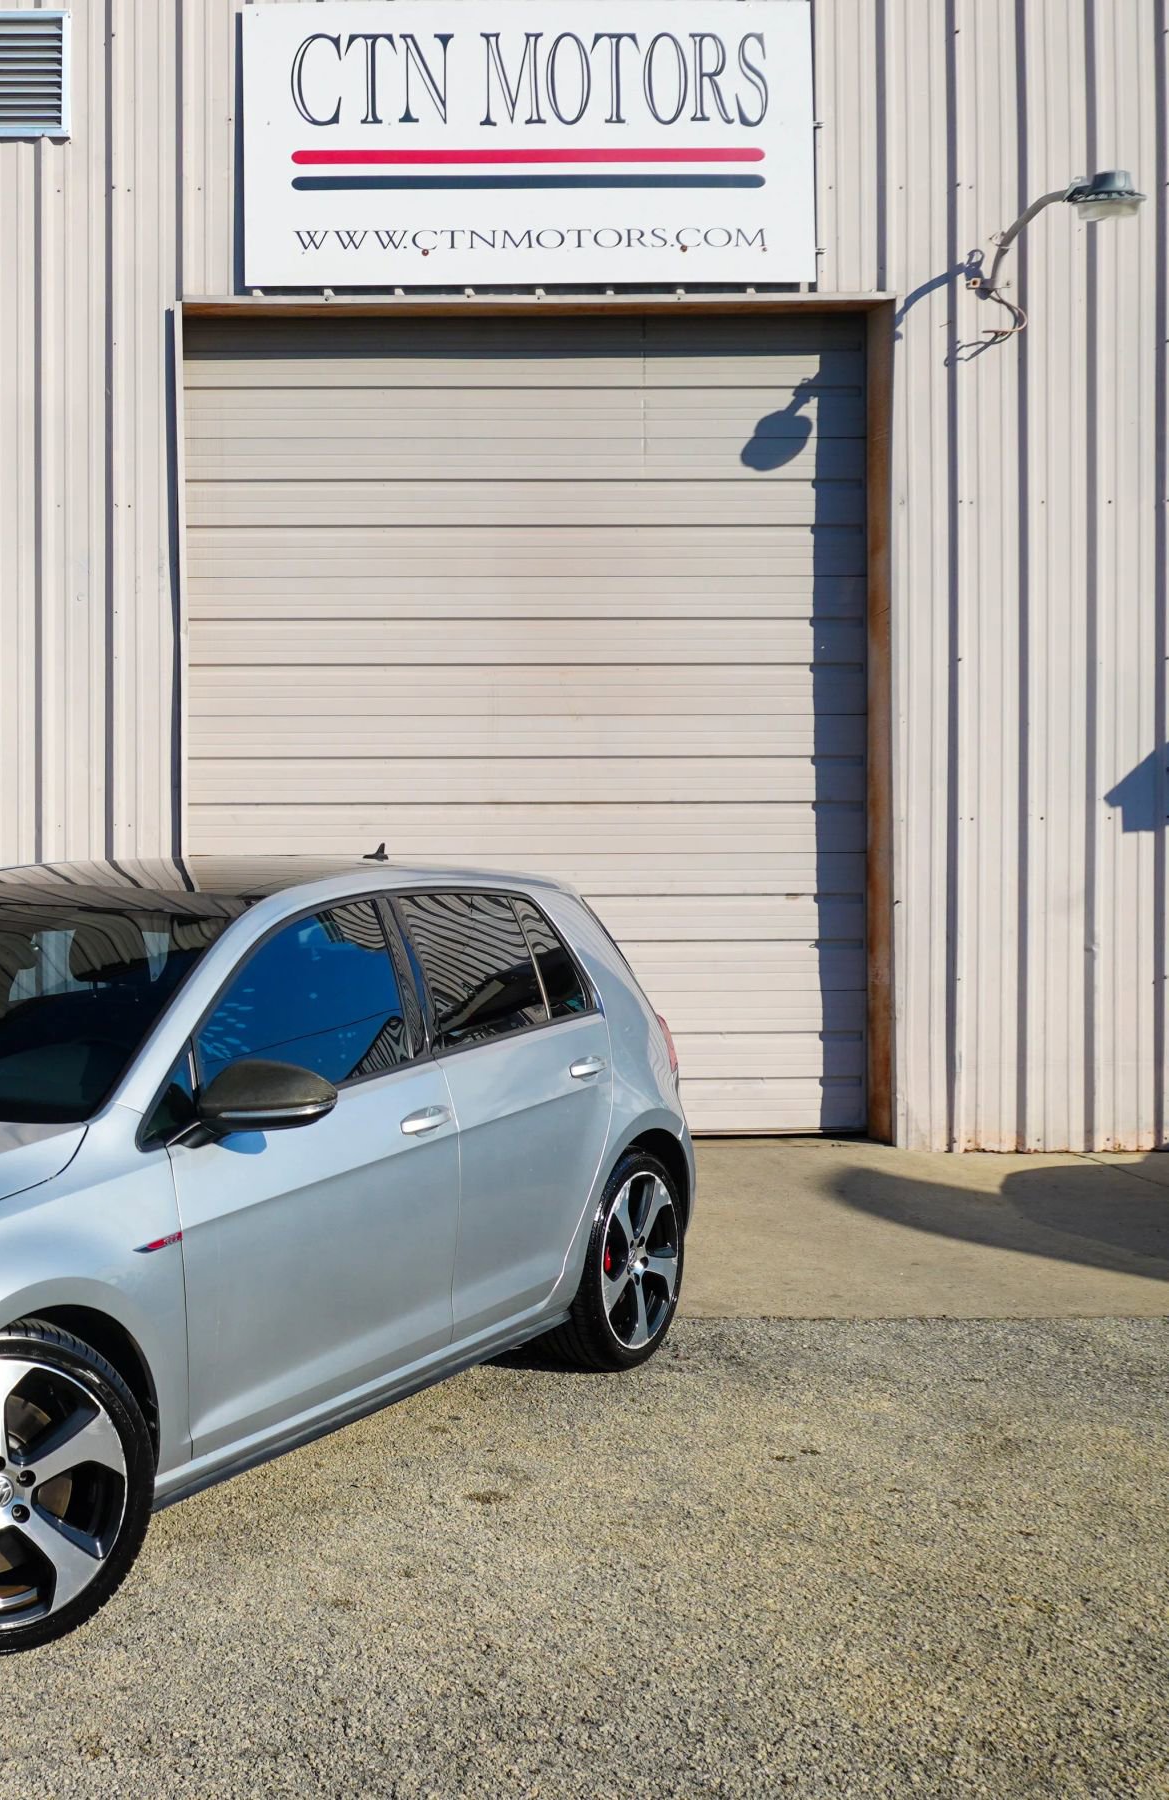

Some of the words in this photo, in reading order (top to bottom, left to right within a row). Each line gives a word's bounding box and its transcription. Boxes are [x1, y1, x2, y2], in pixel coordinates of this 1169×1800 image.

[291, 33, 455, 127] CTN
[479, 31, 769, 128] MOTORS
[293, 227, 767, 251] WWW.CTNMOTORS.COM
